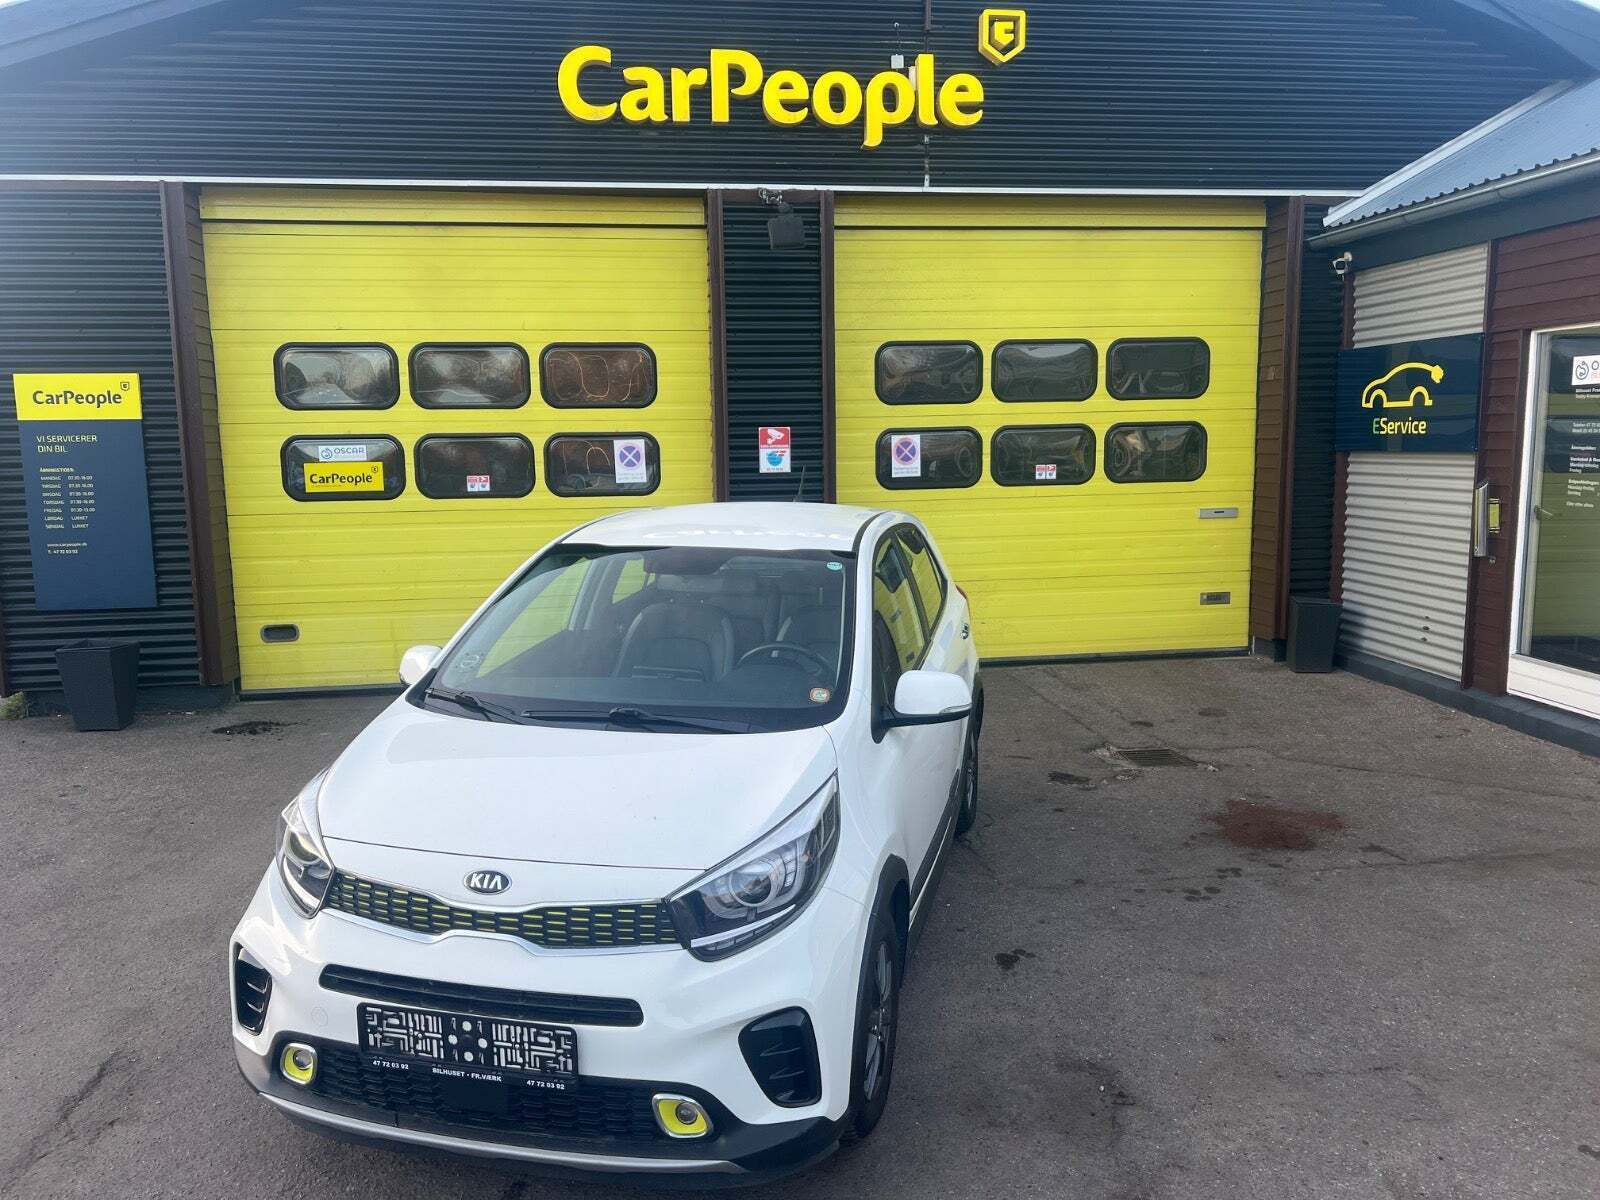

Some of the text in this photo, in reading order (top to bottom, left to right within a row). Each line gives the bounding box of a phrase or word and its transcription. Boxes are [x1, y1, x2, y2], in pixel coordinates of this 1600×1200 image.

[557, 45, 985, 149] CarPeople
[32, 390, 122, 408] CarPeople
[1372, 416, 1427, 434] EService
[36, 434, 98, 443] VI SERVICERER
[37, 445, 68, 453] DIN BIL
[309, 473, 373, 485] CarPeople
[470, 873, 502, 890] KIA
[432, 1067, 465, 1077] BILHUSET
